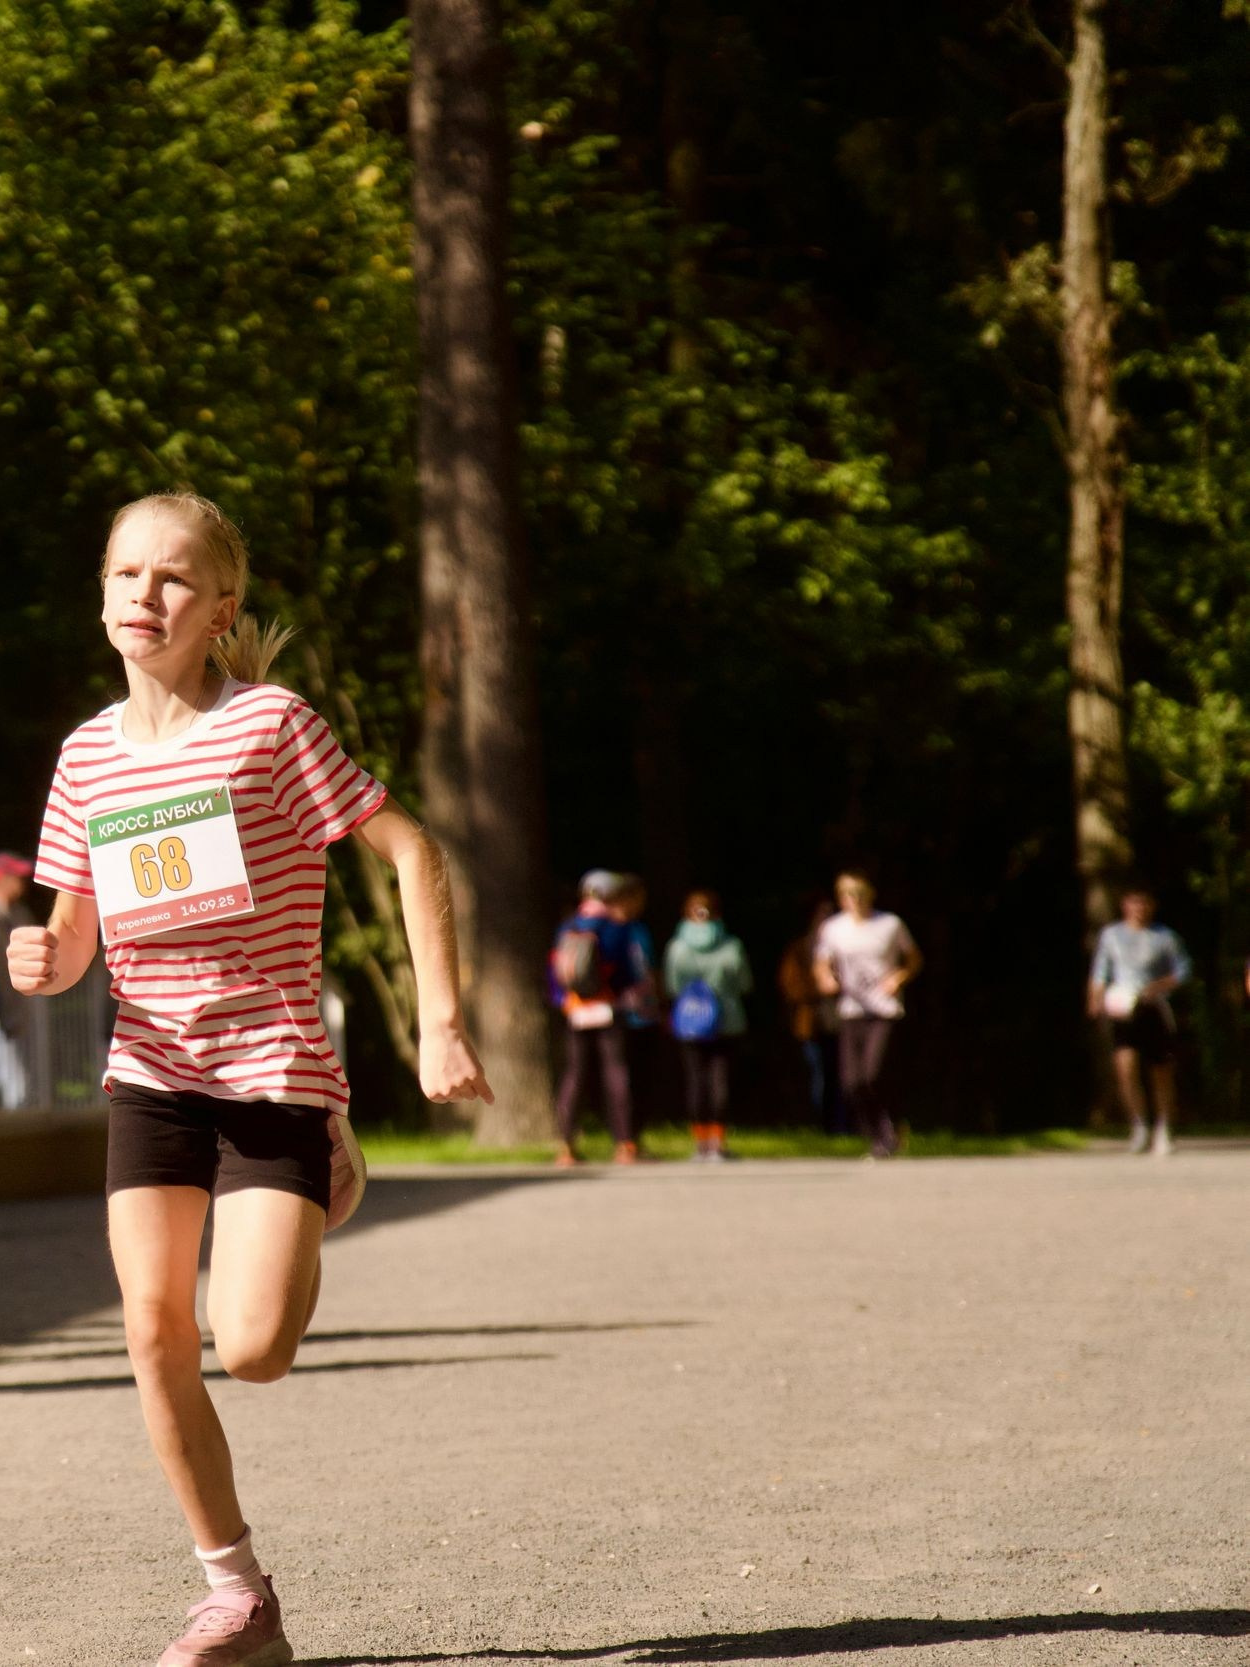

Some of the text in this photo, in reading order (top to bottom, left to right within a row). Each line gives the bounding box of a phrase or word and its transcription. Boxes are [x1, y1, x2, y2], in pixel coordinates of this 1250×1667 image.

[98, 797, 213, 839] КРОСС ДУБКИ
[130, 836, 193, 898] 68
[116, 895, 236, 932] Апрелевка 14.09.25
